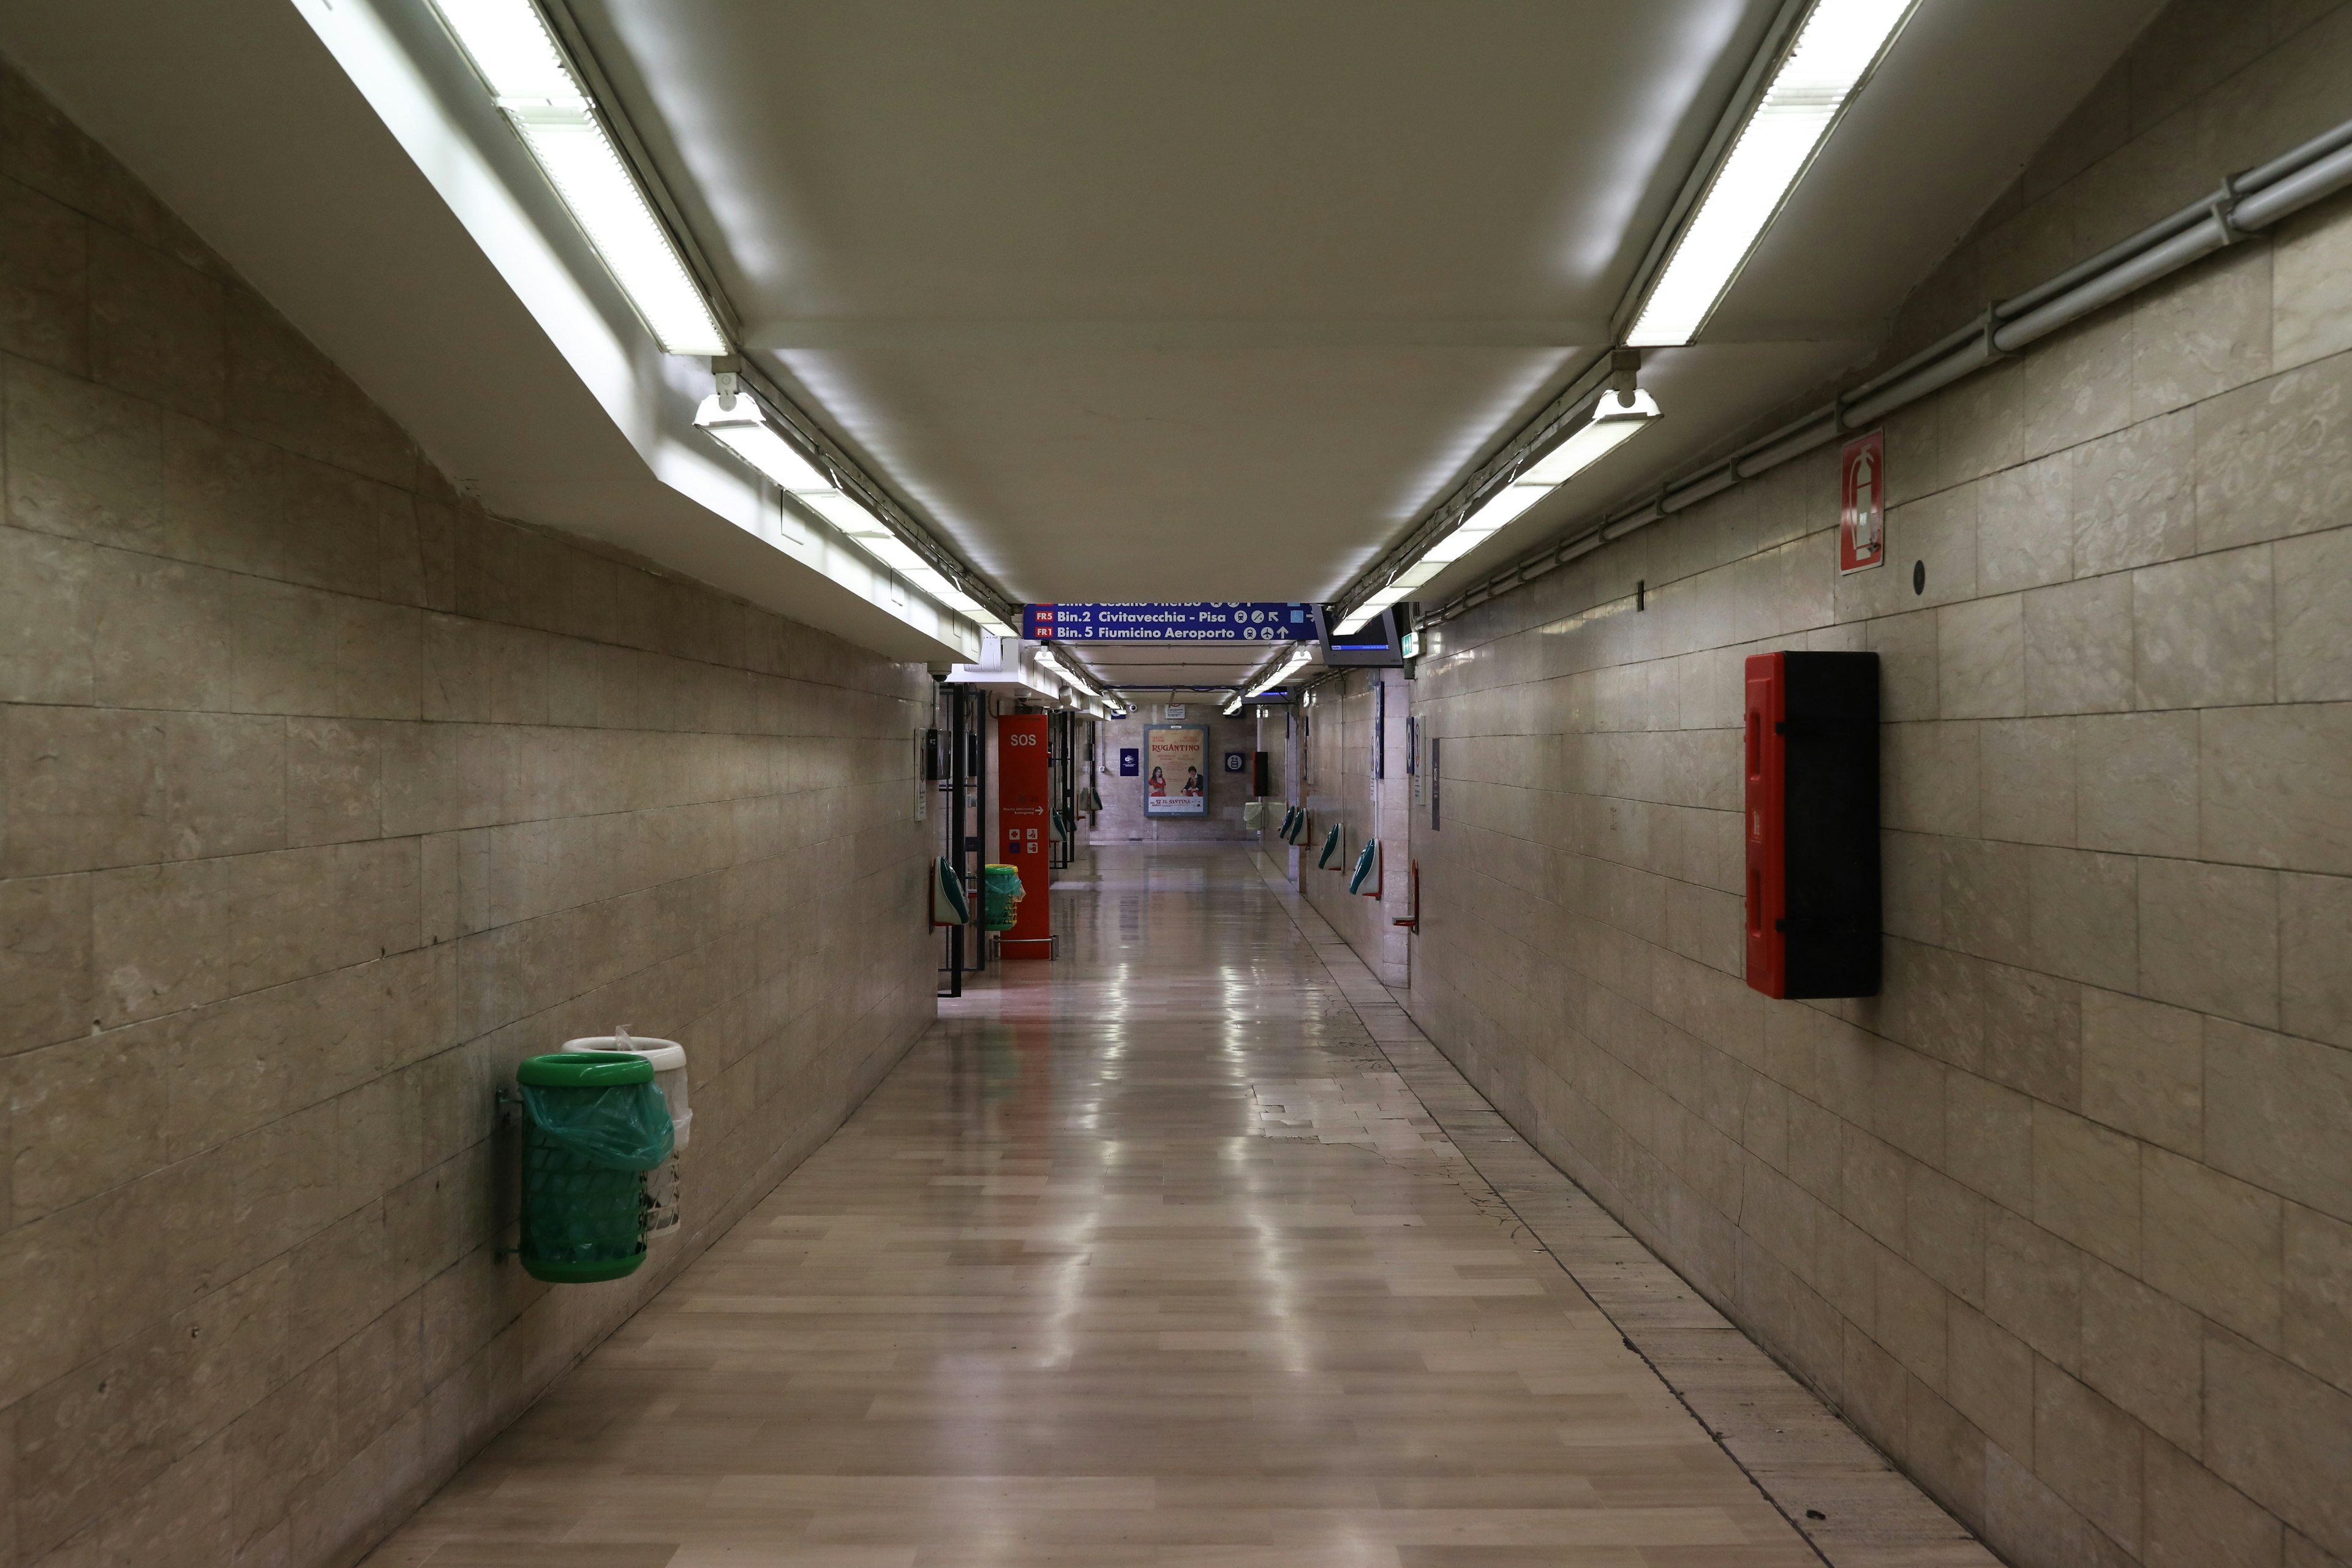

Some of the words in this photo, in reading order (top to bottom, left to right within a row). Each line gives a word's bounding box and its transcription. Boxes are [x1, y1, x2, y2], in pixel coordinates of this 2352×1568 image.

[1057, 611, 1091, 622] Bin.2
[1098, 611, 1186, 622] Civitavecchia
[1199, 611, 1226, 622] Pisa
[1098, 627, 1161, 638] Fiumicino
[1164, 627, 1235, 640] Aeroporto
[1011, 734, 1036, 746] SOS
[1152, 744, 1200, 752] RUGANTINO
